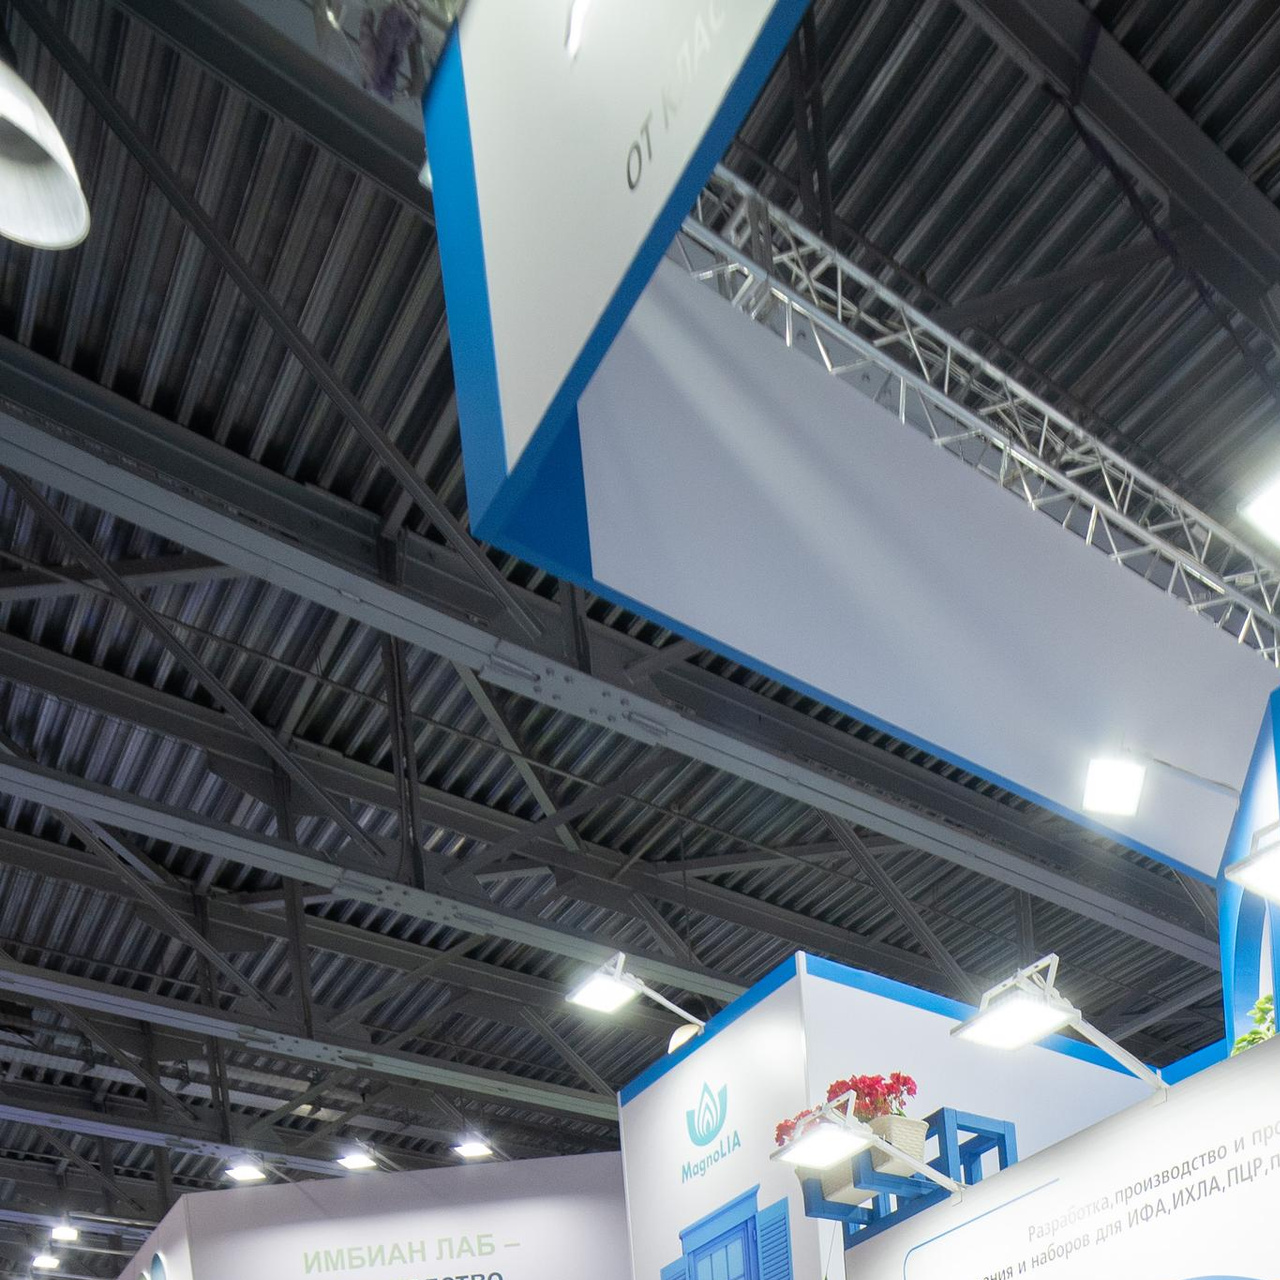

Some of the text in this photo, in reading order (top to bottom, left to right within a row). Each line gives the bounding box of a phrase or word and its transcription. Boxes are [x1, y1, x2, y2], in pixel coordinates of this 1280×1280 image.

[626, 108, 653, 191] ОТ
[682, 1130, 741, 1183] MagnoLIA
[1234, 1137, 1245, 1154] и
[303, 1239, 427, 1275] ИМБИАН
[436, 1233, 496, 1261] ЛАБ
[1018, 1259, 1027, 1275] и
[1031, 1232, 1090, 1270] наборов
[1095, 1219, 1122, 1246] для
